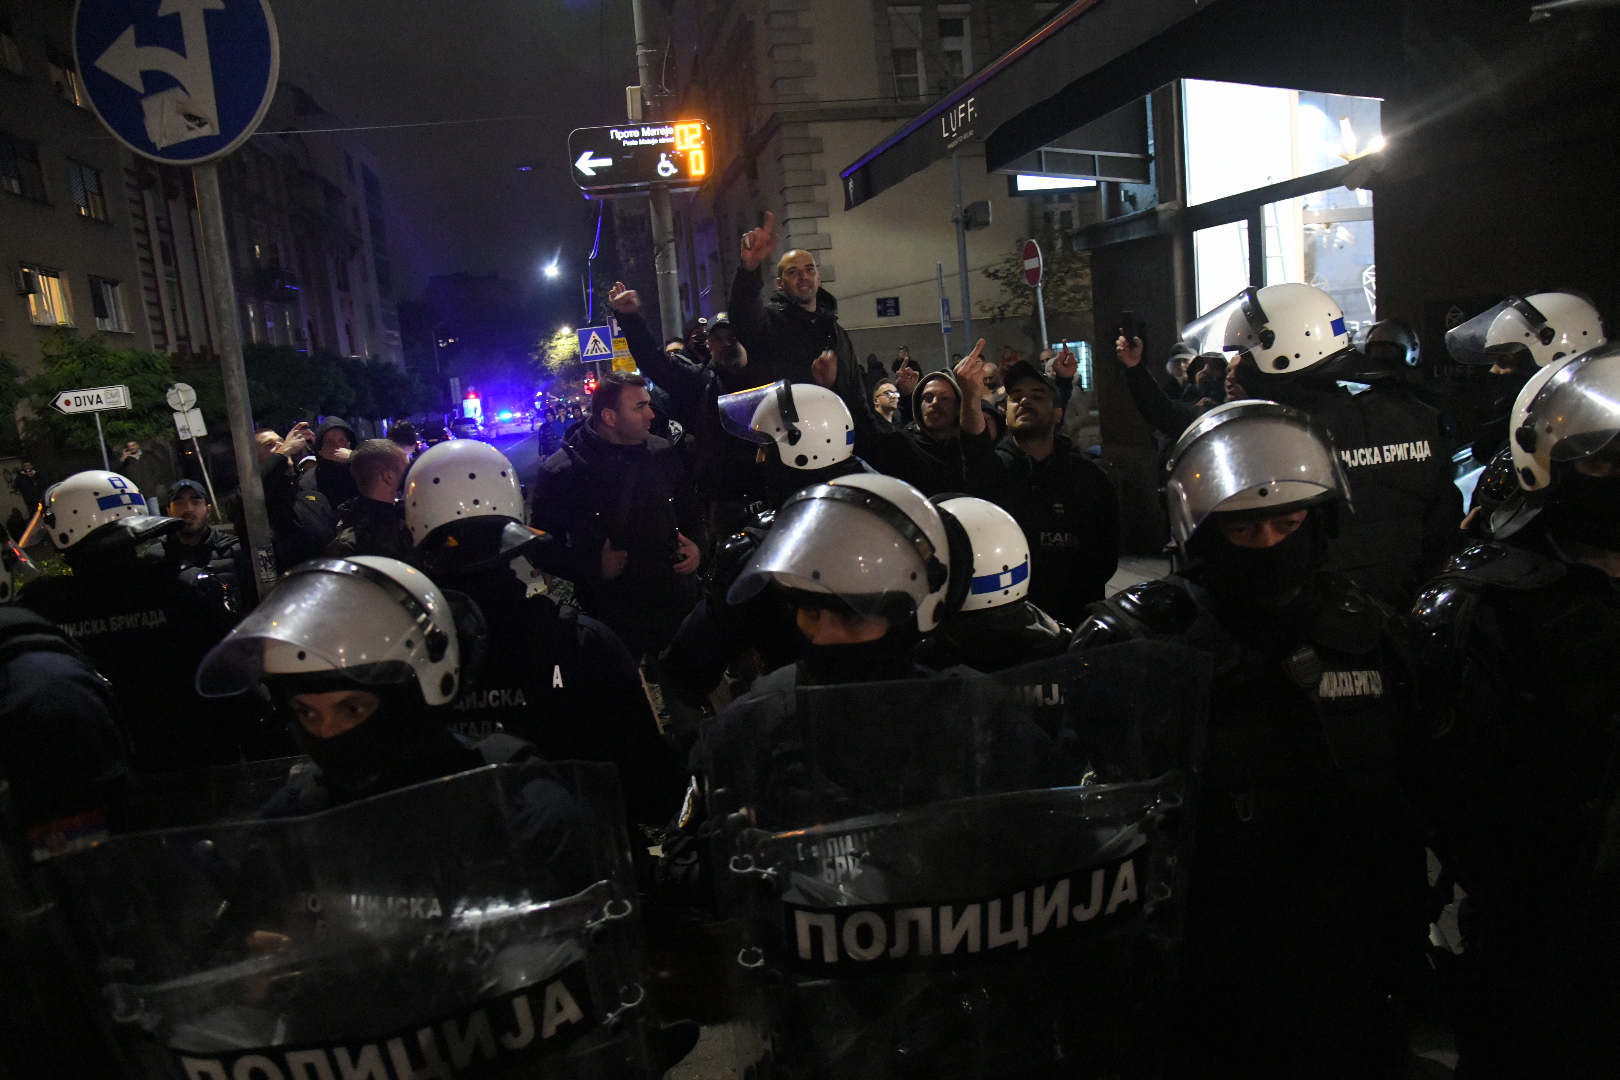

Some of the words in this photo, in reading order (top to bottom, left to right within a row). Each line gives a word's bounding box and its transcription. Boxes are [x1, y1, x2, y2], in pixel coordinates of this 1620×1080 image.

[610, 129, 640, 140] Проте
[641, 125, 674, 137] Матеје
[675, 124, 702, 150] 02
[689, 149, 705, 175] 0
[74, 394, 103, 407] DIVA
[1382, 440, 1431, 462] БРИГАДА
[109, 610, 167, 632] БРИГАДА
[794, 859, 1138, 963] ПОЛИЦИЈА
